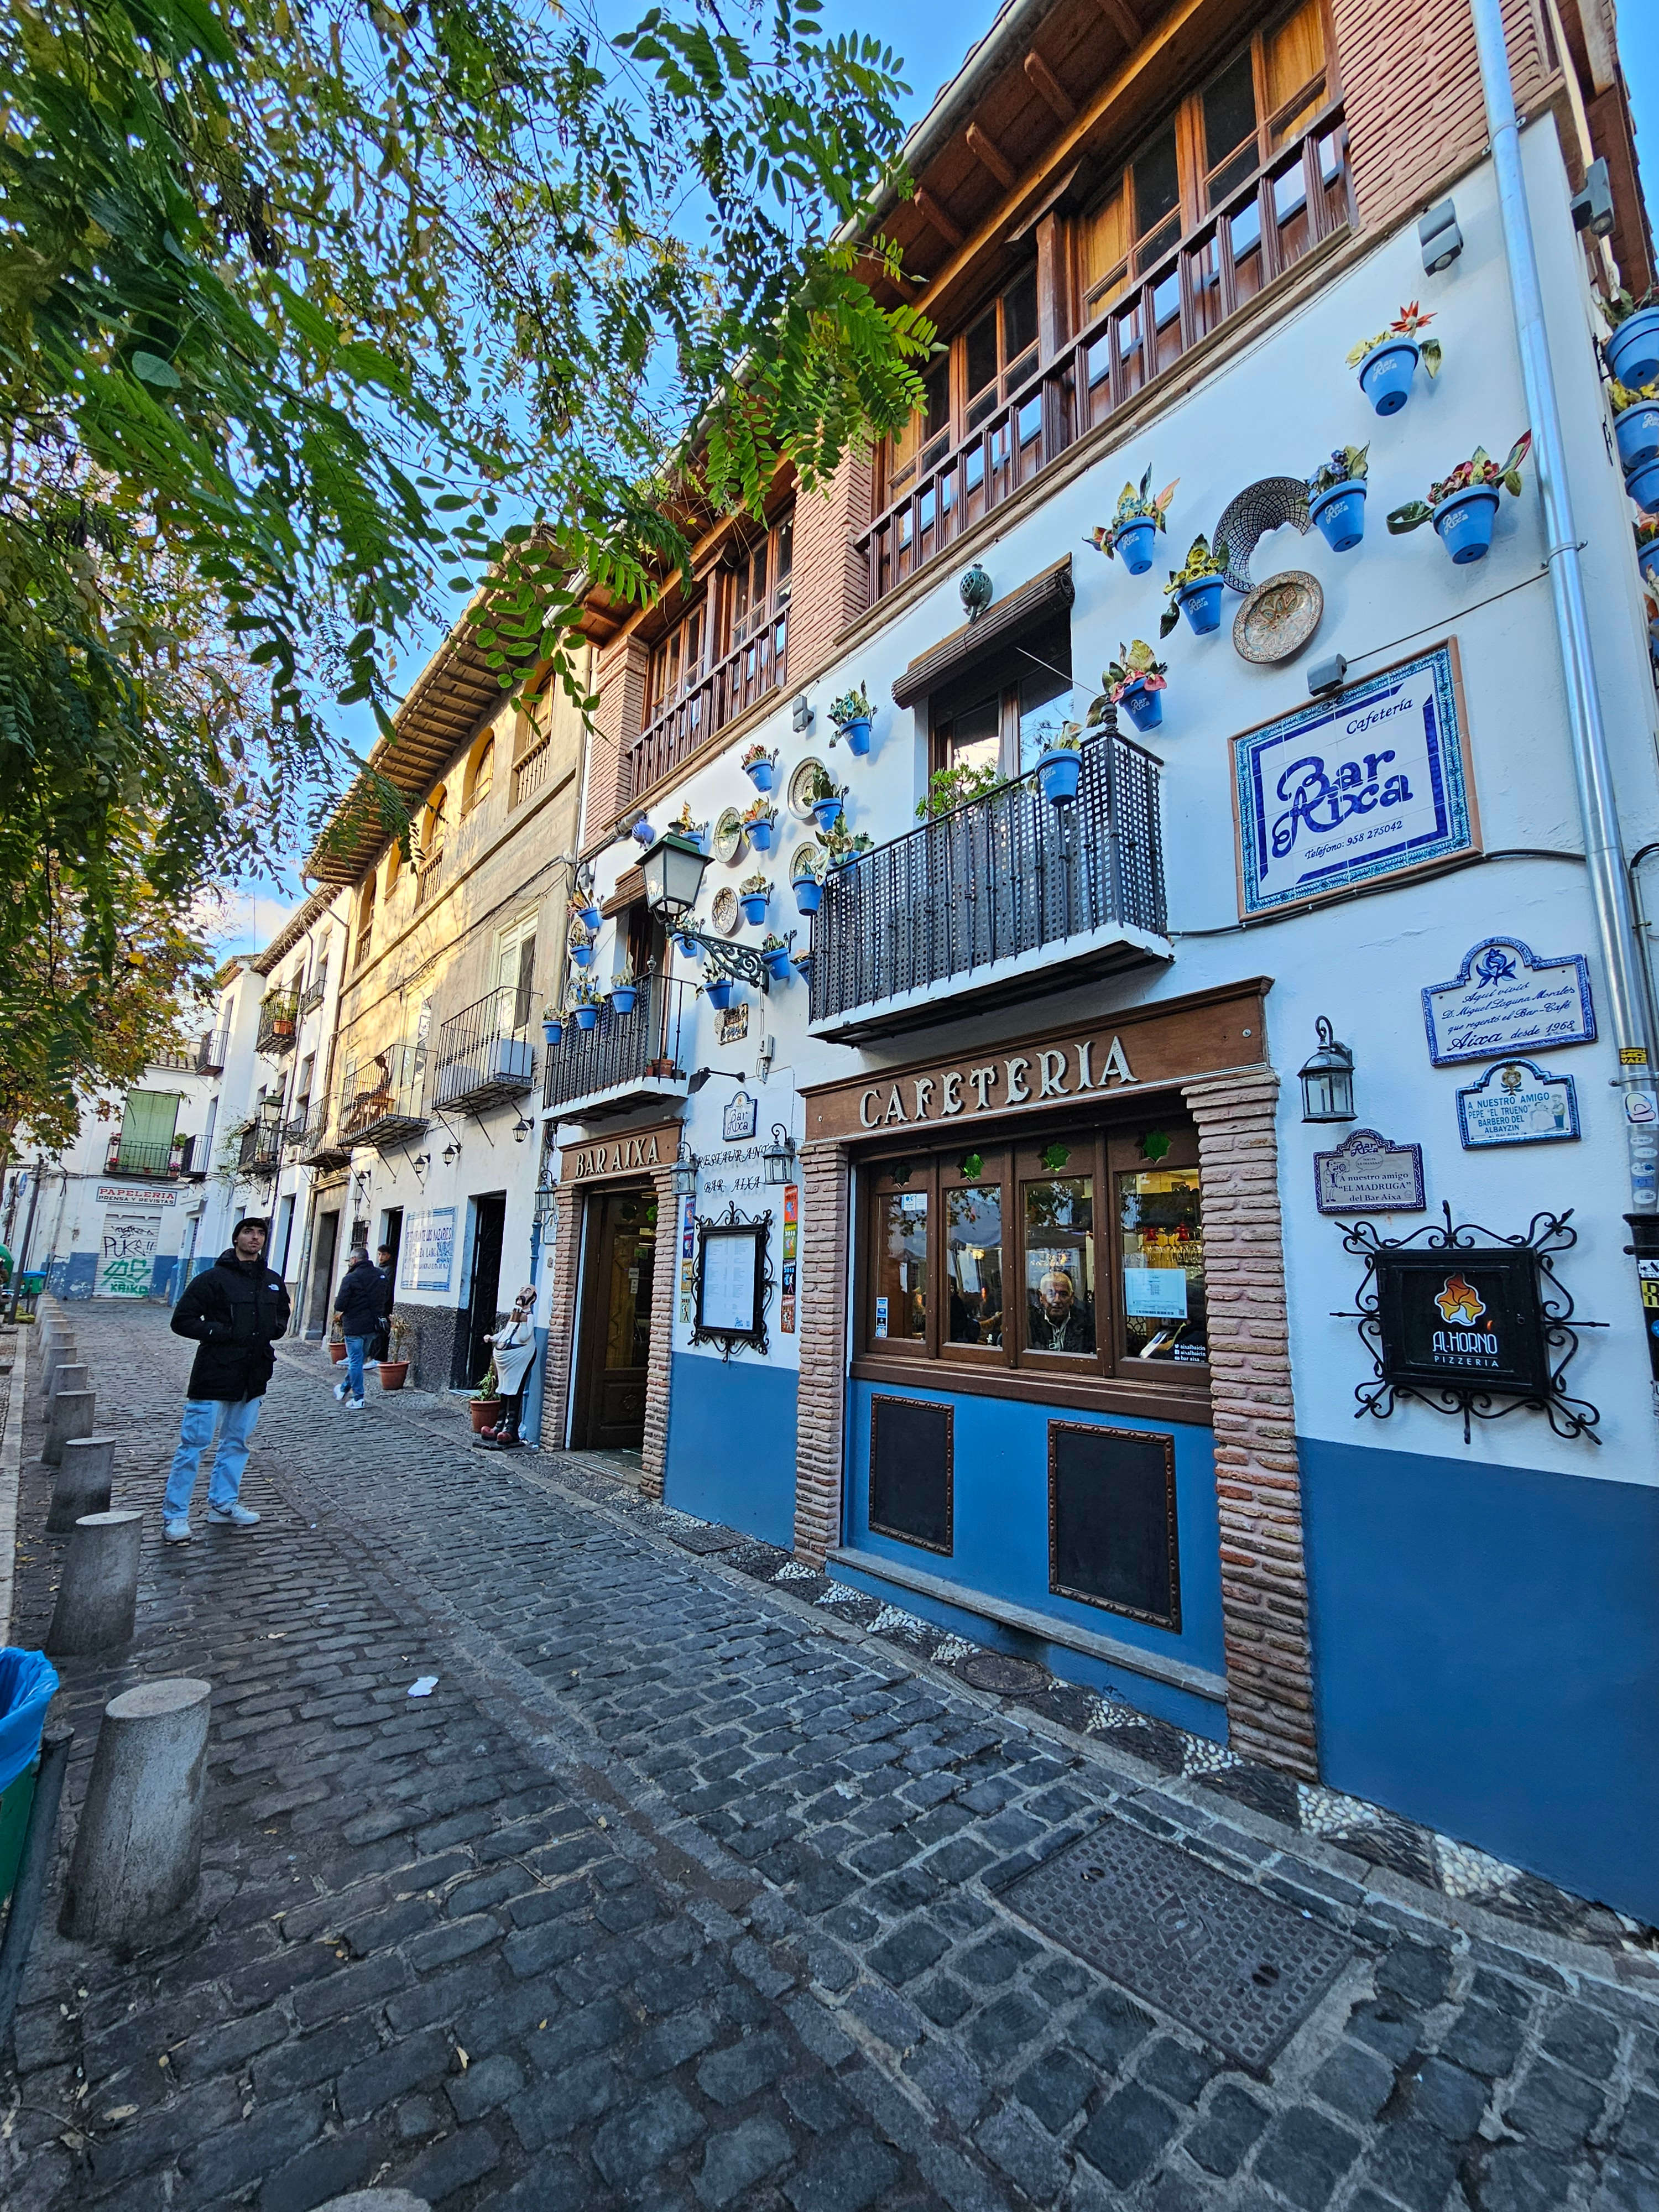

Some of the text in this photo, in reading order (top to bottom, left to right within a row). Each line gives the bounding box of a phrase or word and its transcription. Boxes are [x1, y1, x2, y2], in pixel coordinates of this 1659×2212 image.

[1346, 698, 1412, 734] Cafetería
[1277, 749, 1396, 801] Bar
[1272, 774, 1413, 859] Aixa
[1346, 831, 1364, 848] 958
[1367, 820, 1403, 840] 275042
[1442, 985, 1575, 1020] D. Miguel Laguna Morales
[1447, 1023, 1464, 1035] que
[1501, 1013, 1514, 1022] el
[1447, 1020, 1575, 1051] Aixa desde 1968
[860, 1035, 1139, 1129] CAFETERIA
[1468, 1092, 1550, 1110] A NUESTRO AMIGO
[1468, 1109, 1484, 1119] PEPE
[1478, 1114, 1525, 1127] BARBERO DEL
[1484, 1124, 1520, 1134] ALBAYZIN
[575, 1135, 661, 1178] BAR AIXA
[704, 1176, 760, 1193] BAR AIXA
[1382, 1172, 1408, 1181] amigo
[100, 1188, 174, 1199] PAPELERIA
[1432, 1331, 1498, 1354] AL-HORNO
[1434, 1355, 1499, 1368] PIZZERIA
